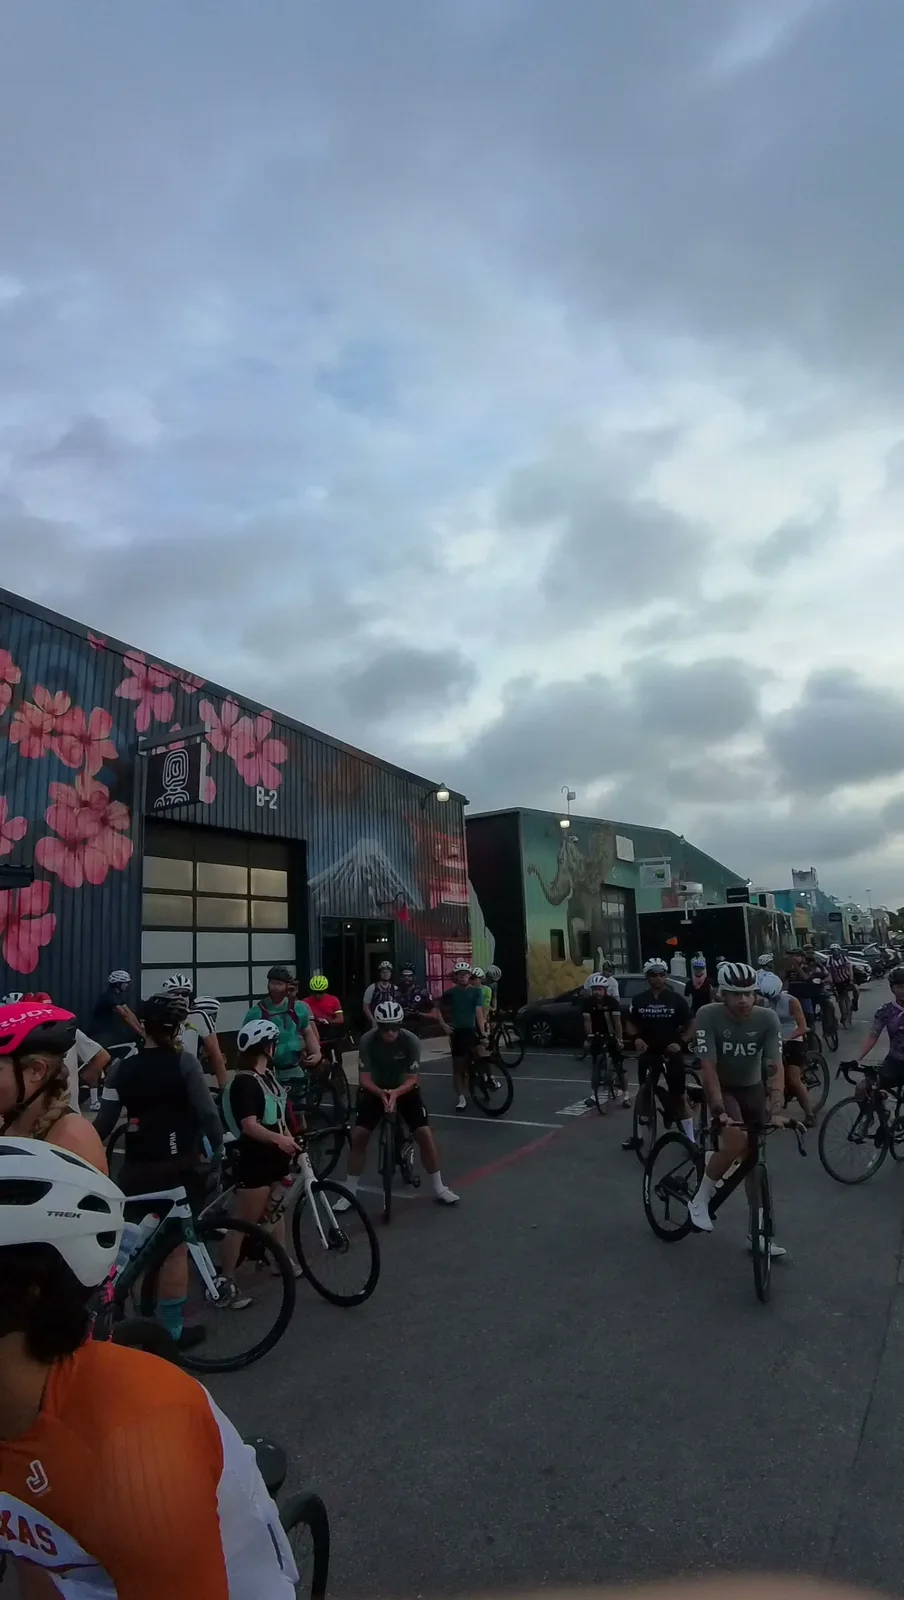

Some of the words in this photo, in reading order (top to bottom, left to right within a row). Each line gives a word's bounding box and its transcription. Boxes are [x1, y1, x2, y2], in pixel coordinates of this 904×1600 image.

[256, 785, 278, 810] B-2
[696, 1029, 708, 1053] PAS
[722, 1041, 758, 1057] PAS
[46, 1210, 82, 1219] TREK
